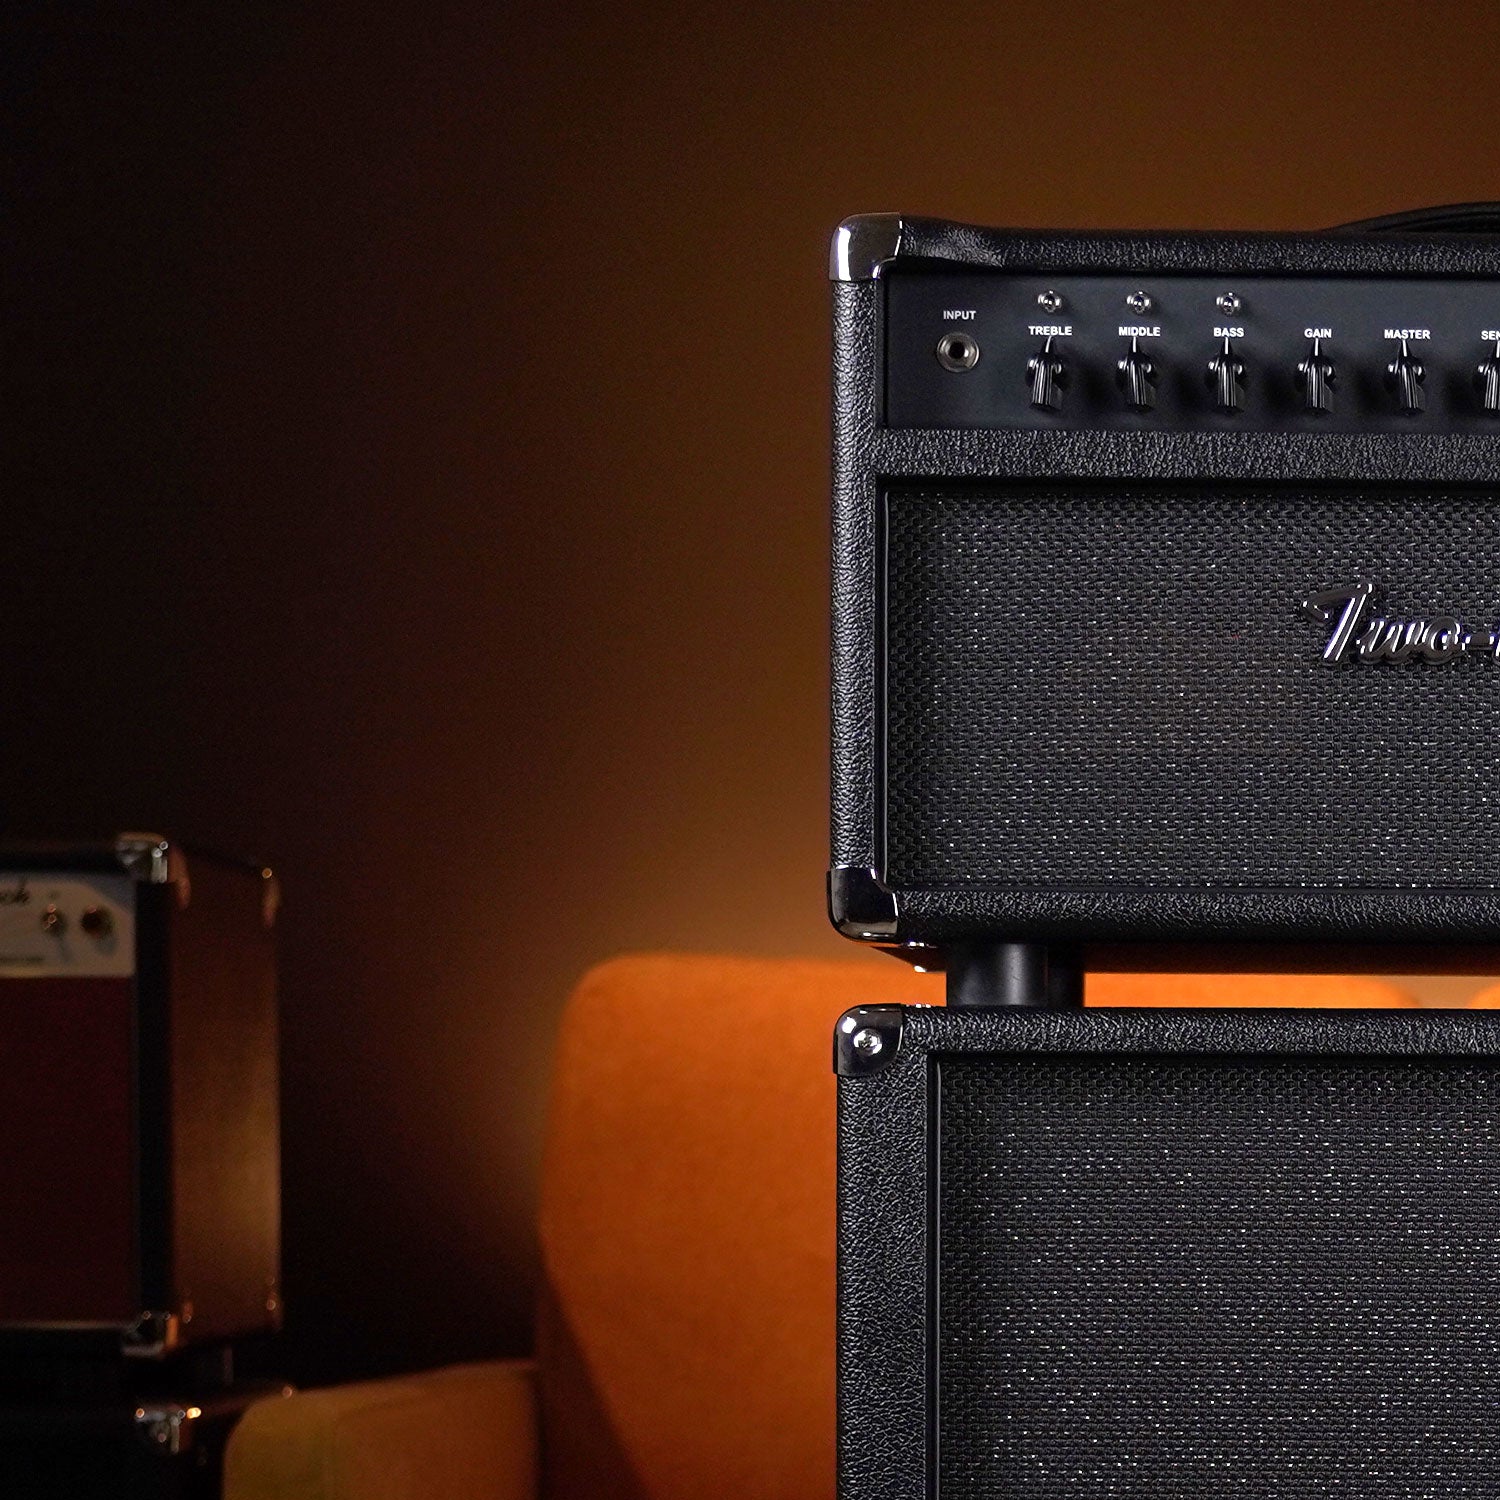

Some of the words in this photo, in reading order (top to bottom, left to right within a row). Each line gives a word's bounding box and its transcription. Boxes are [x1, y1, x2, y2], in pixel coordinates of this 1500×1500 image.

[943, 310, 976, 320] INPUT
[1028, 325, 1073, 336] TREBLE
[1118, 326, 1161, 337] MIDDLE
[1213, 327, 1245, 338] BASS
[1304, 328, 1332, 339] GAIN
[1384, 329, 1431, 339] MASTER
